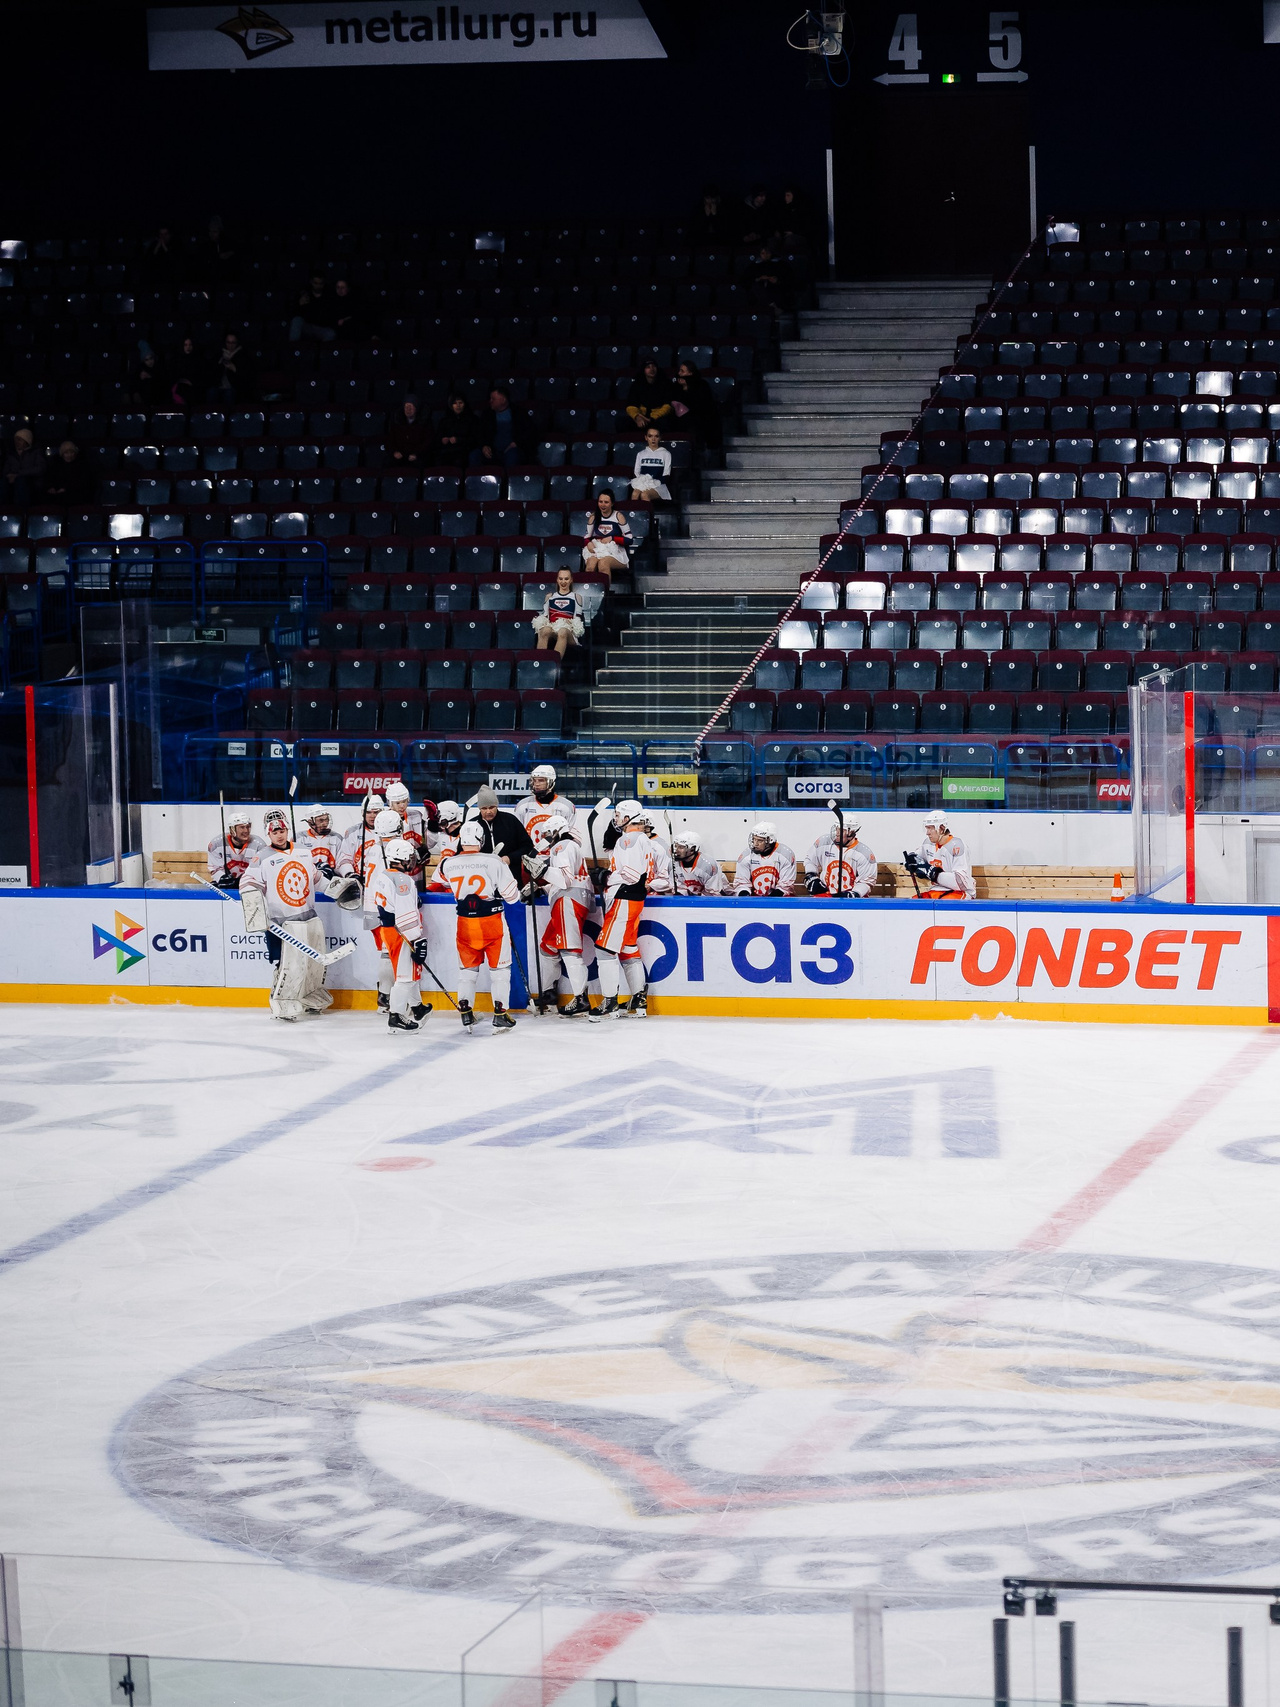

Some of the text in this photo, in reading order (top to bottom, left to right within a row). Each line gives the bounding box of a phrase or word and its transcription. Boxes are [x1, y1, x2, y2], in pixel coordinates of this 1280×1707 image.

[325, 6, 598, 47] metallurg.ru
[888, 13, 922, 70] 4
[989, 11, 1022, 69] 5
[345, 777, 400, 789] FONBET
[492, 779, 534, 791] KHL.
[661, 780, 692, 790] БАНК
[1099, 784, 1161, 796] FONET
[450, 874, 489, 900] 72
[152, 928, 208, 953] сбп
[230, 934, 358, 949] систе трых
[269, 924, 319, 960] WARRIOR
[230, 951, 270, 960] плате
[910, 926, 1242, 990] FONBET
